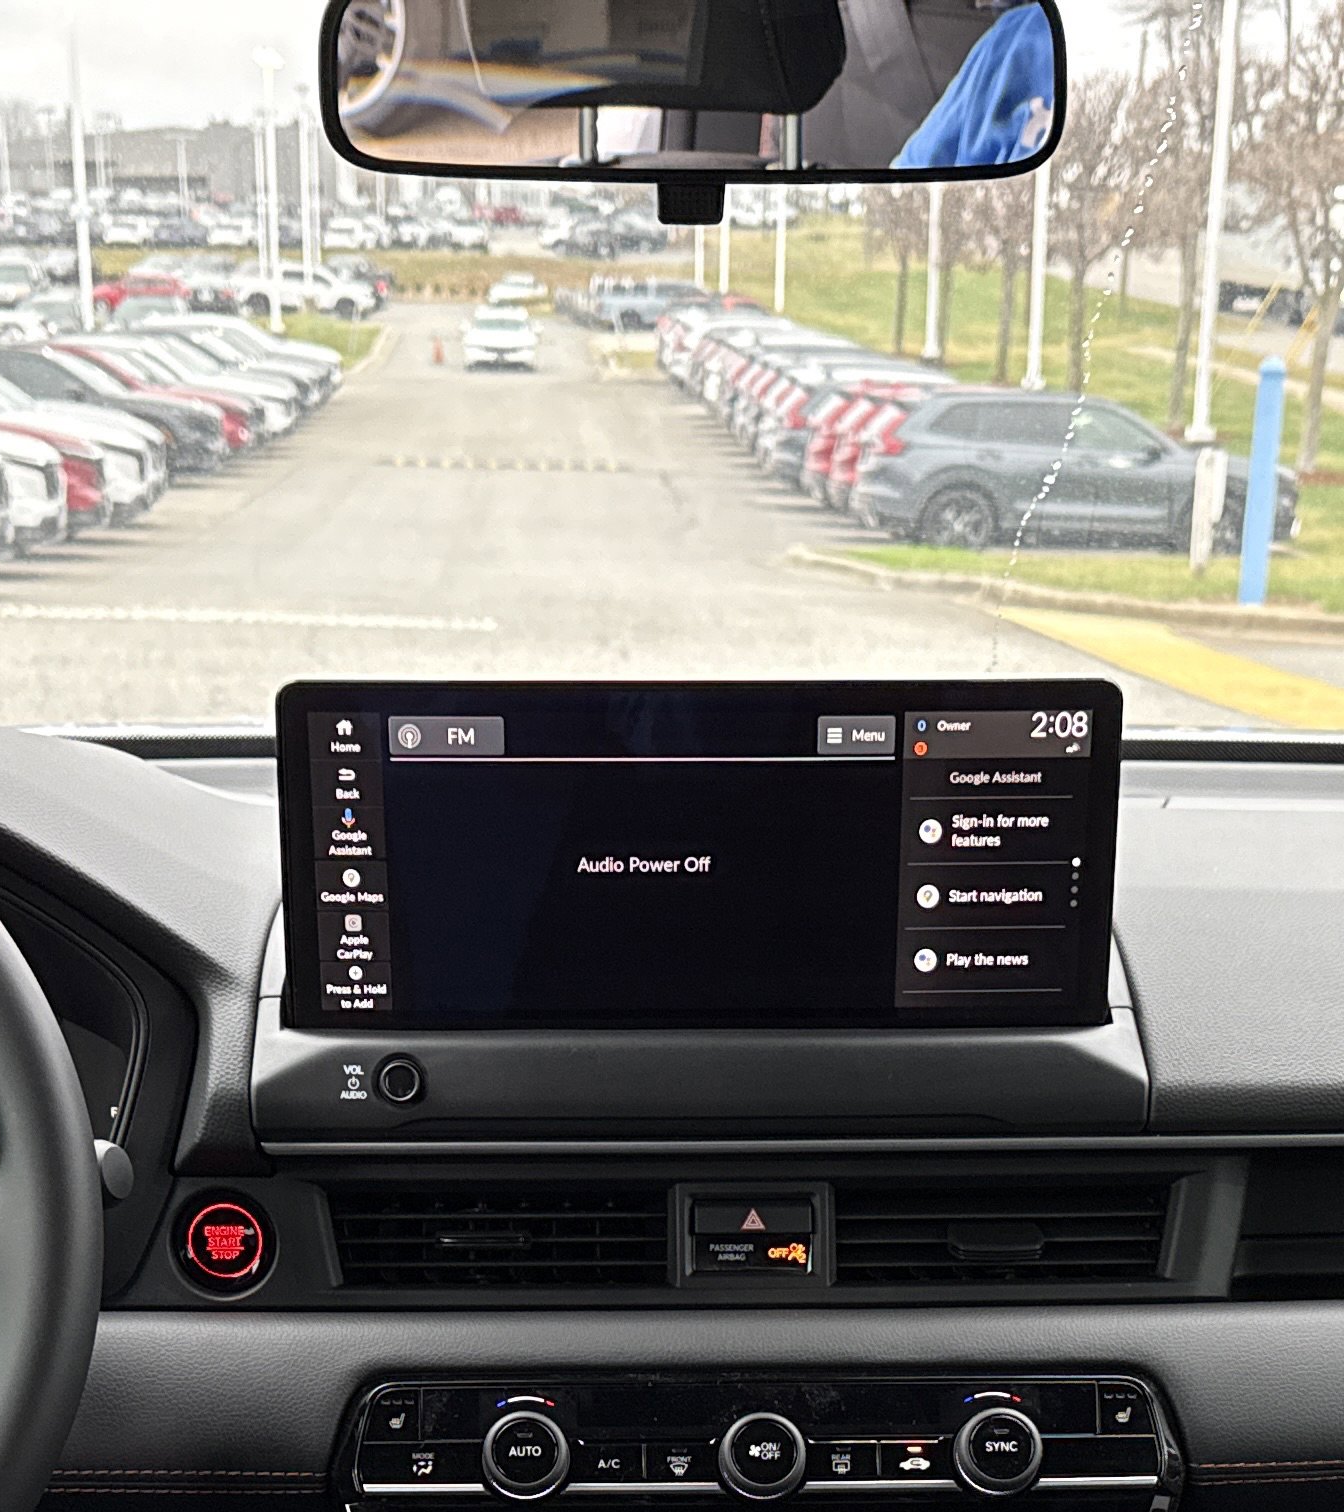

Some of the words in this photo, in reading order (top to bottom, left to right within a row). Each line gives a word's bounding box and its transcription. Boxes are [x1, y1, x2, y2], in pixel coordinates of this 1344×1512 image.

[937, 720, 971, 732] Owner
[1030, 710, 1088, 738] 2:08
[447, 727, 475, 745] FM
[851, 729, 886, 742] Menu
[330, 741, 361, 753] Home
[949, 771, 991, 785] Google
[992, 770, 1042, 784] Assistant
[336, 788, 360, 800] Back
[952, 814, 995, 830] Sign-in
[997, 814, 1015, 828] for
[1017, 816, 1049, 828] more
[331, 830, 368, 843] Google
[951, 834, 1001, 847] features
[328, 845, 372, 856] Assistant
[577, 856, 625, 873] Audio
[629, 856, 680, 873] Power
[684, 856, 711, 873] Off
[320, 892, 356, 904] Google
[358, 892, 384, 904] Maps
[948, 889, 978, 903] Start
[980, 888, 1043, 905] navigation
[340, 935, 369, 947] Apple
[337, 949, 373, 961] CarPlay
[946, 953, 972, 969] Play
[974, 953, 994, 966] the
[996, 955, 1029, 966] news
[326, 984, 352, 995] Press
[353, 984, 361, 994] &
[363, 984, 387, 995] Hold
[341, 999, 352, 1009] to
[353, 999, 374, 1009] Add
[342, 1064, 365, 1076] VOL
[339, 1090, 368, 1100] AUDIO
[204, 1225, 245, 1237] ENGINE
[207, 1237, 242, 1247] START
[709, 1244, 754, 1252] PASSENGER
[211, 1250, 240, 1260] STOP
[717, 1253, 746, 1261] AIRBAG
[767, 1247, 789, 1259] OFF
[509, 1446, 542, 1457] AUTO
[761, 1442, 781, 1451] ON/
[985, 1441, 1018, 1452] SYNC
[412, 1452, 435, 1460] MODE
[666, 1455, 692, 1463] FRONT
[761, 1452, 781, 1460] OFF
[597, 1458, 621, 1469] A/C
